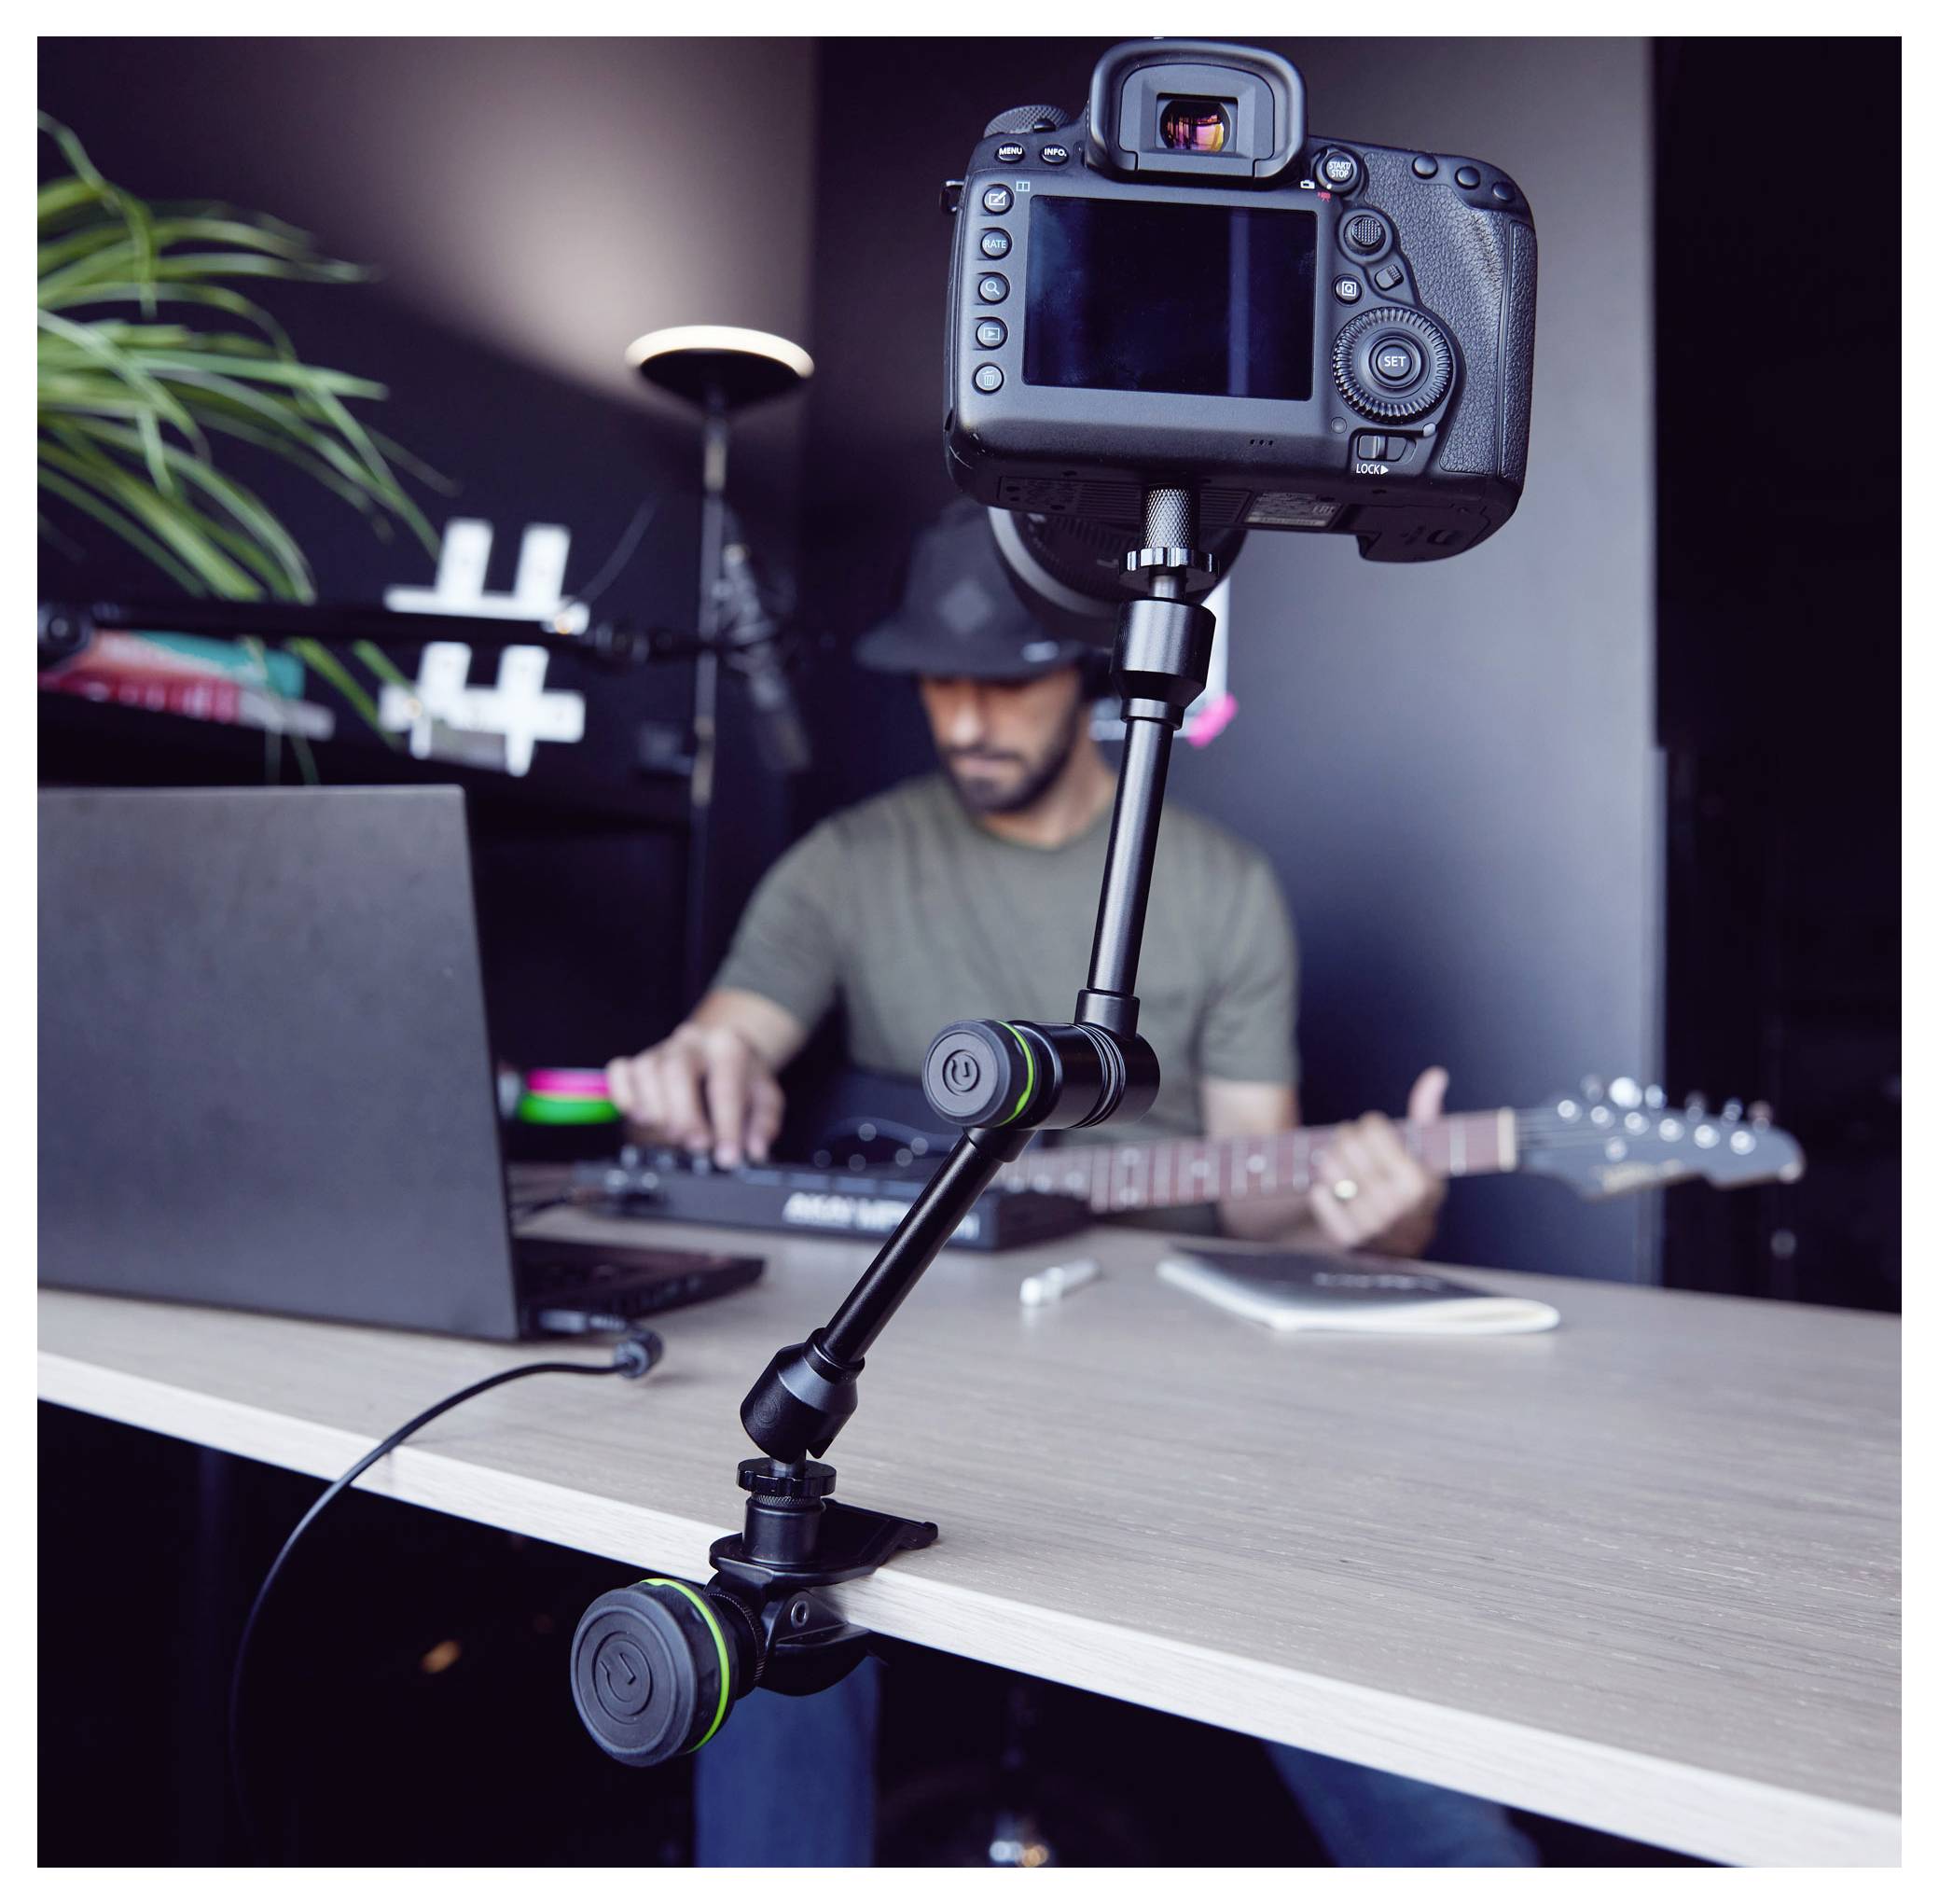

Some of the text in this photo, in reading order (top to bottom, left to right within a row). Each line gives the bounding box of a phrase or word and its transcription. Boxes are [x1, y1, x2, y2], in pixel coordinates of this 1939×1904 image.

[998, 146, 1023, 155] MENU
[1044, 147, 1067, 157] INFO.
[1331, 169, 1349, 178] STOP
[984, 239, 1007, 249] RATE
[1383, 355, 1406, 367] SET
[1355, 463, 1380, 475] LOCK
